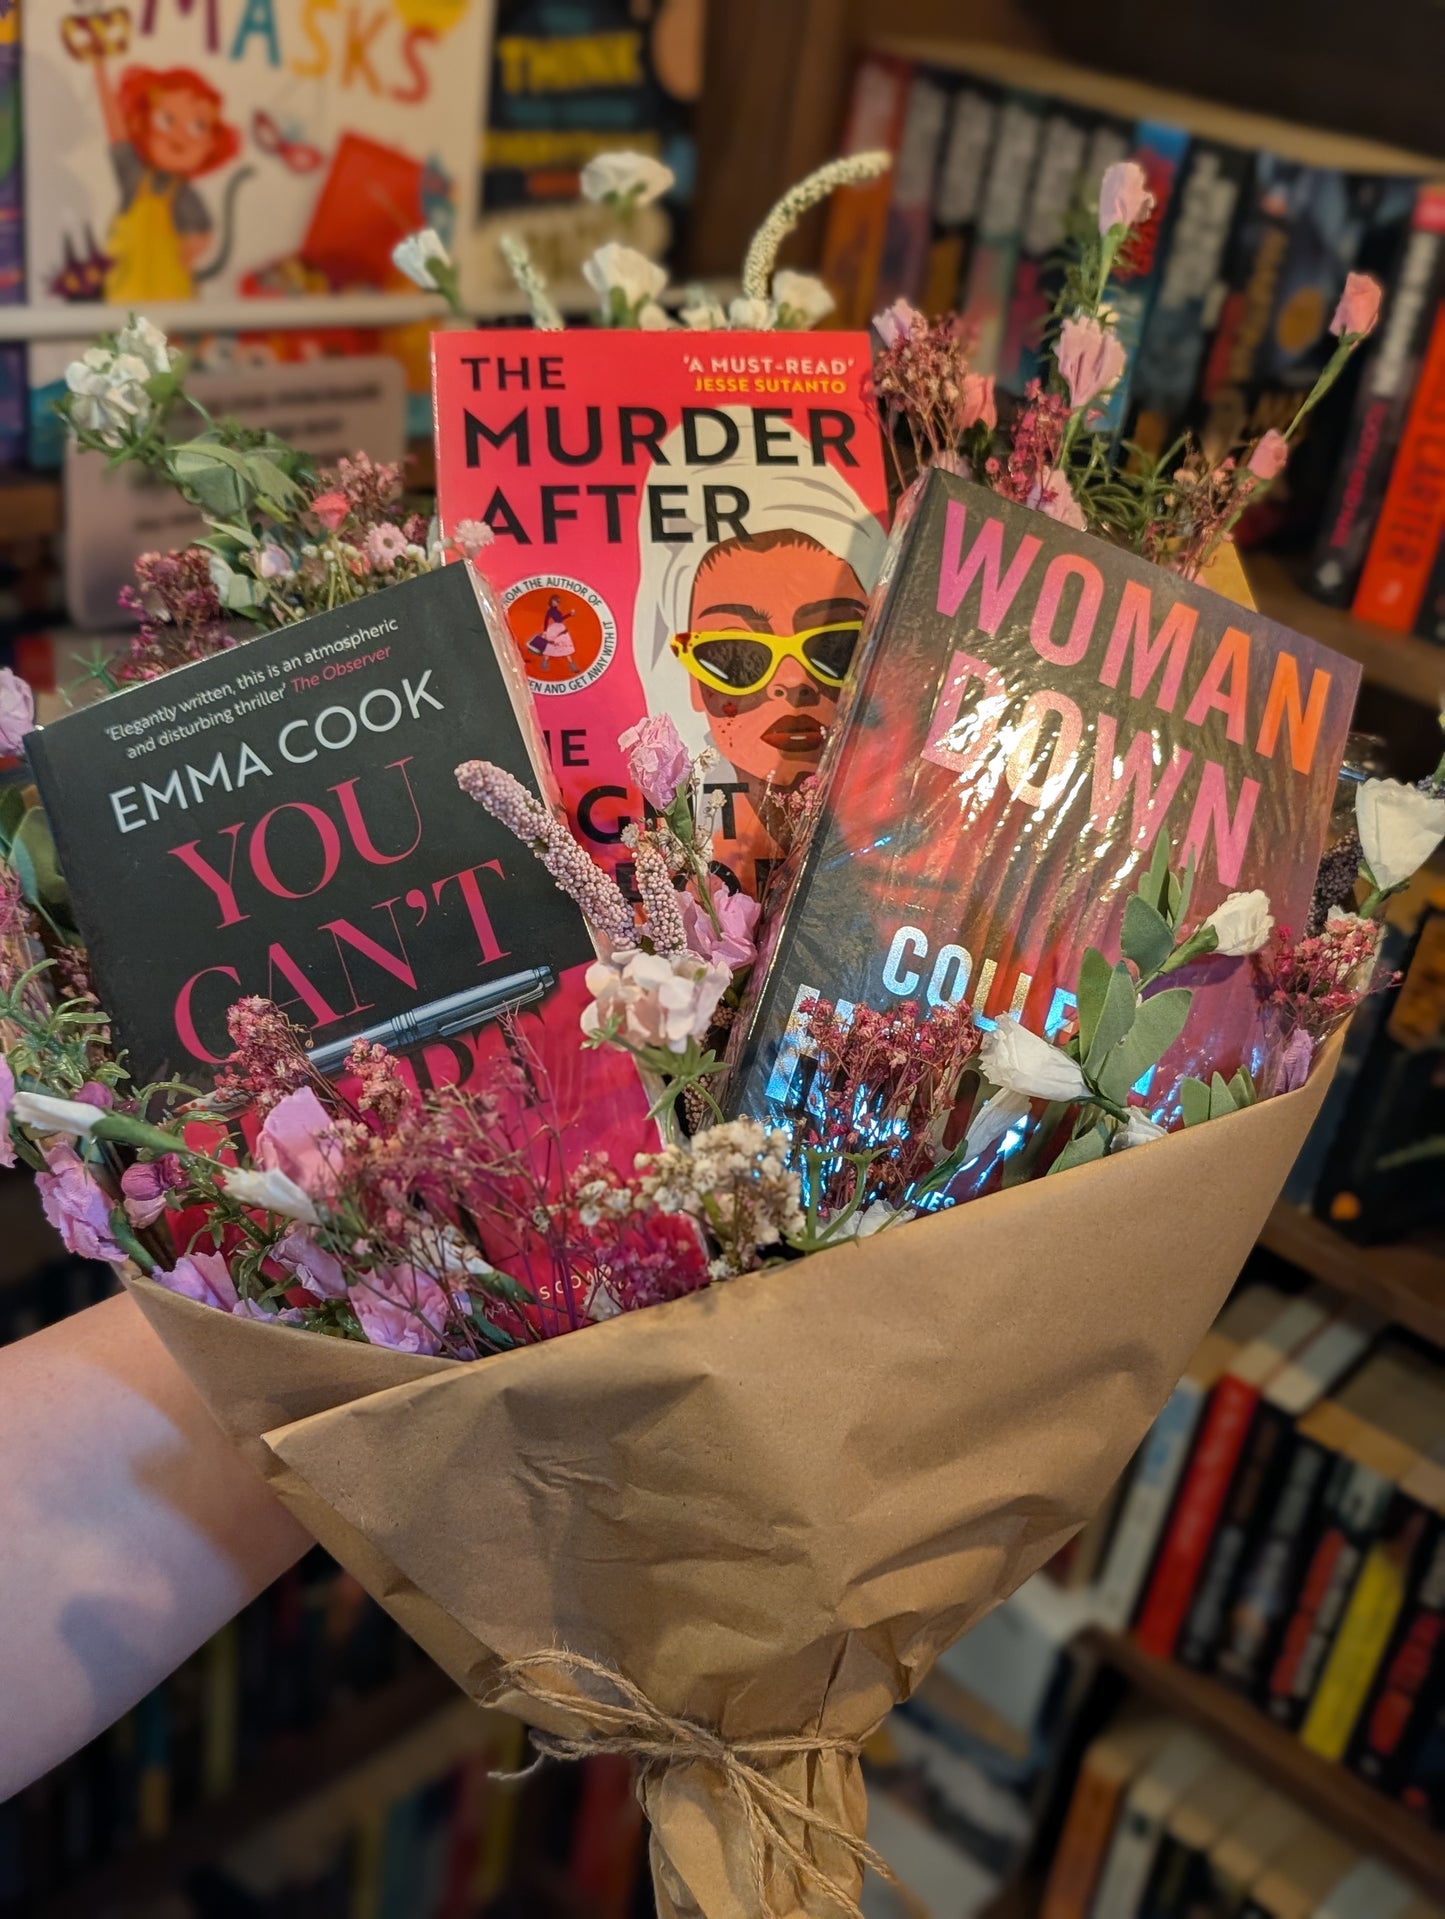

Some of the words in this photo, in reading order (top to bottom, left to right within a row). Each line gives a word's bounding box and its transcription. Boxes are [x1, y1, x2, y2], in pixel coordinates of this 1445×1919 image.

[460, 356, 566, 391] THE
[695, 377, 749, 392] JESSE
[754, 378, 846, 394] SUTANTO
[463, 405, 860, 468] MURDER
[481, 485, 752, 544] AFTER
[522, 577, 543, 591] THE
[546, 577, 588, 597] AUTHOR
[588, 594, 602, 607] OF
[601, 632, 615, 656] WITH
[602, 621, 613, 630] IT
[935, 500, 1332, 776] WOMAN
[236, 670, 266, 691] this
[266, 663, 281, 679] is
[282, 656, 303, 674] an
[303, 616, 399, 665] atmospheric
[587, 656, 609, 680] AWAY
[126, 735, 157, 761] and
[157, 706, 236, 749] disturbing
[289, 672, 321, 693] The
[322, 646, 392, 682] Observer
[544, 683, 567, 694] AND
[568, 676, 588, 691] GET
[109, 741, 273, 834] EMMA
[277, 669, 444, 764] COOK
[921, 649, 1262, 888] DOWN
[167, 756, 424, 930] YOU
